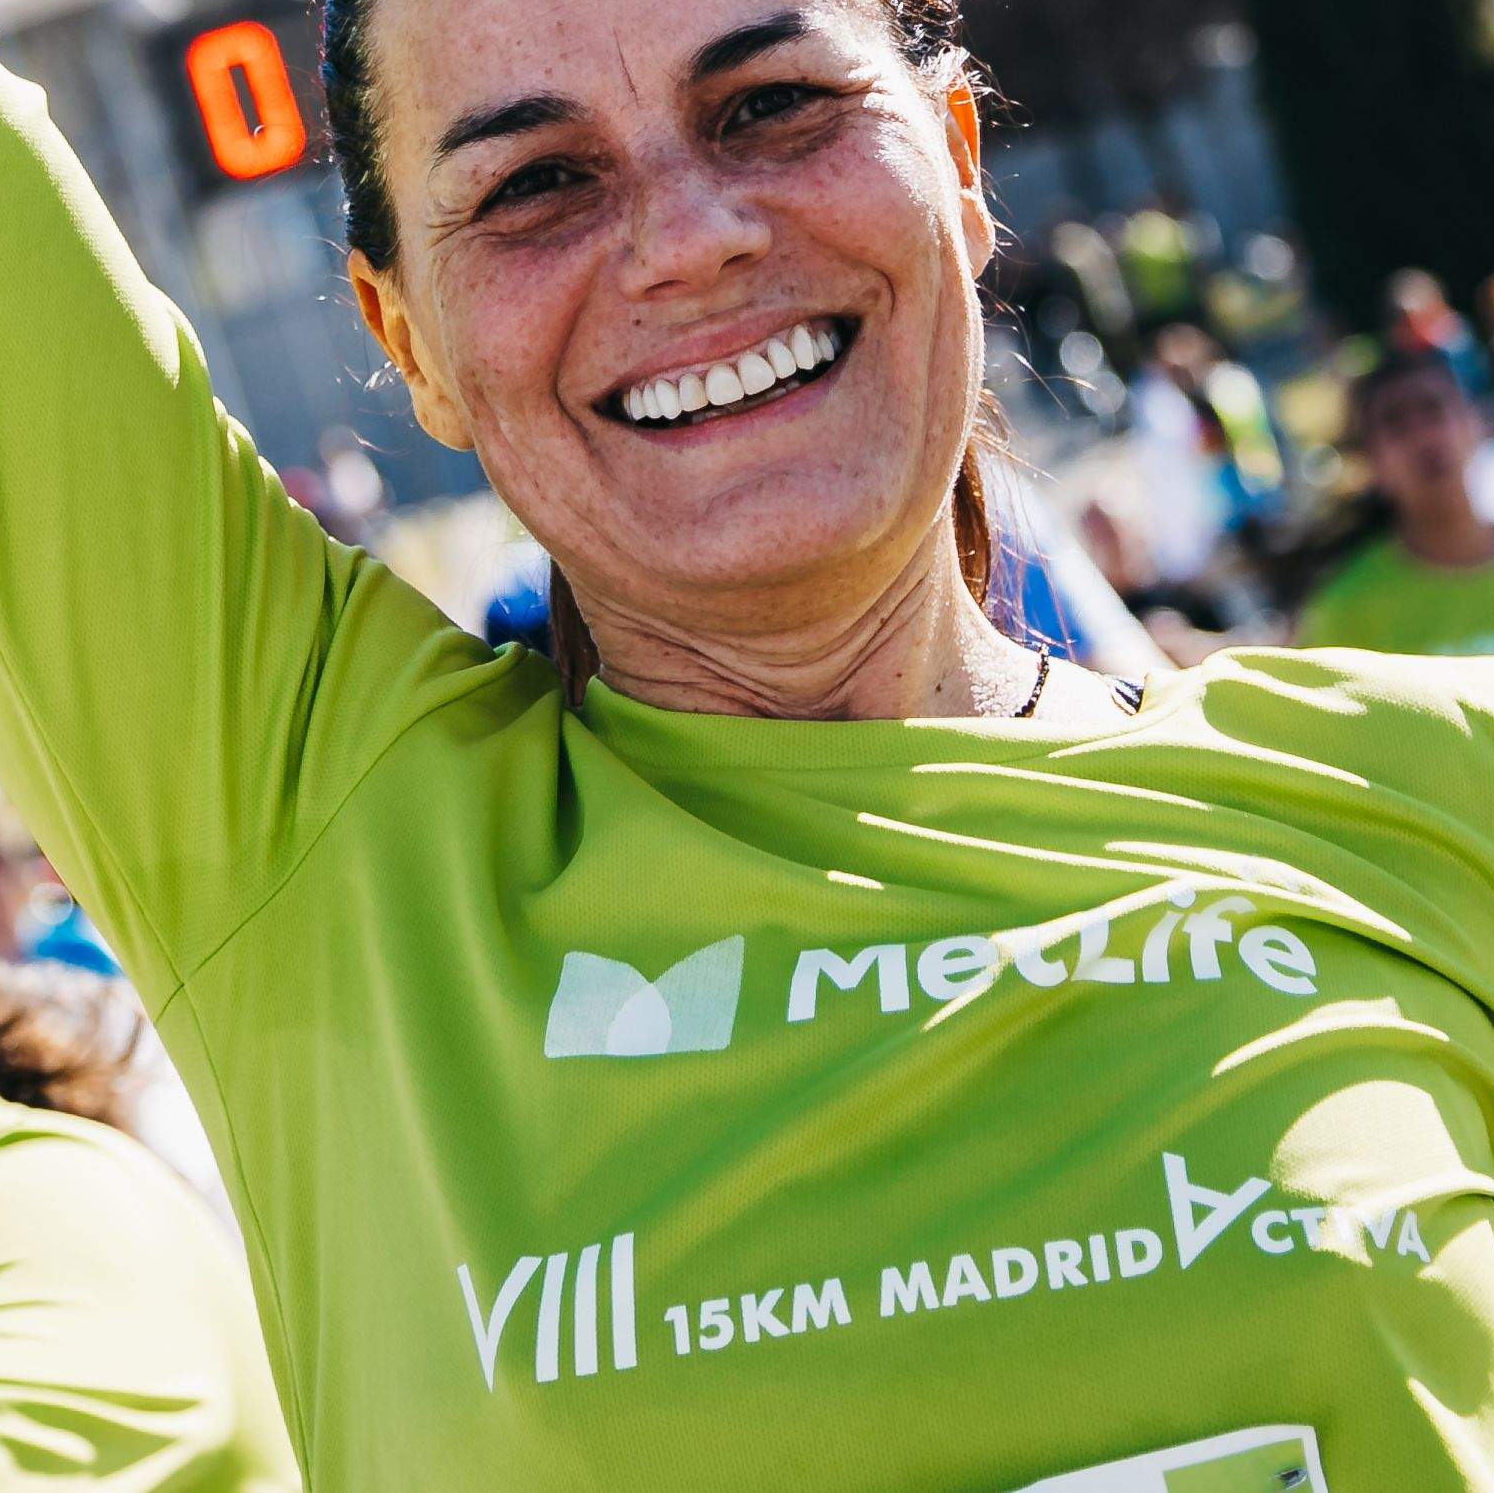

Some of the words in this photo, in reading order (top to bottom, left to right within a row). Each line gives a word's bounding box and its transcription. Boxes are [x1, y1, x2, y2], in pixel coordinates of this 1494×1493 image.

[185, 20, 307, 182] 0
[786, 883, 1319, 1023] MetLife
[456, 1232, 638, 1393] VIII
[663, 1278, 852, 1356] 15KM
[879, 1227, 1164, 1317] MADRID
